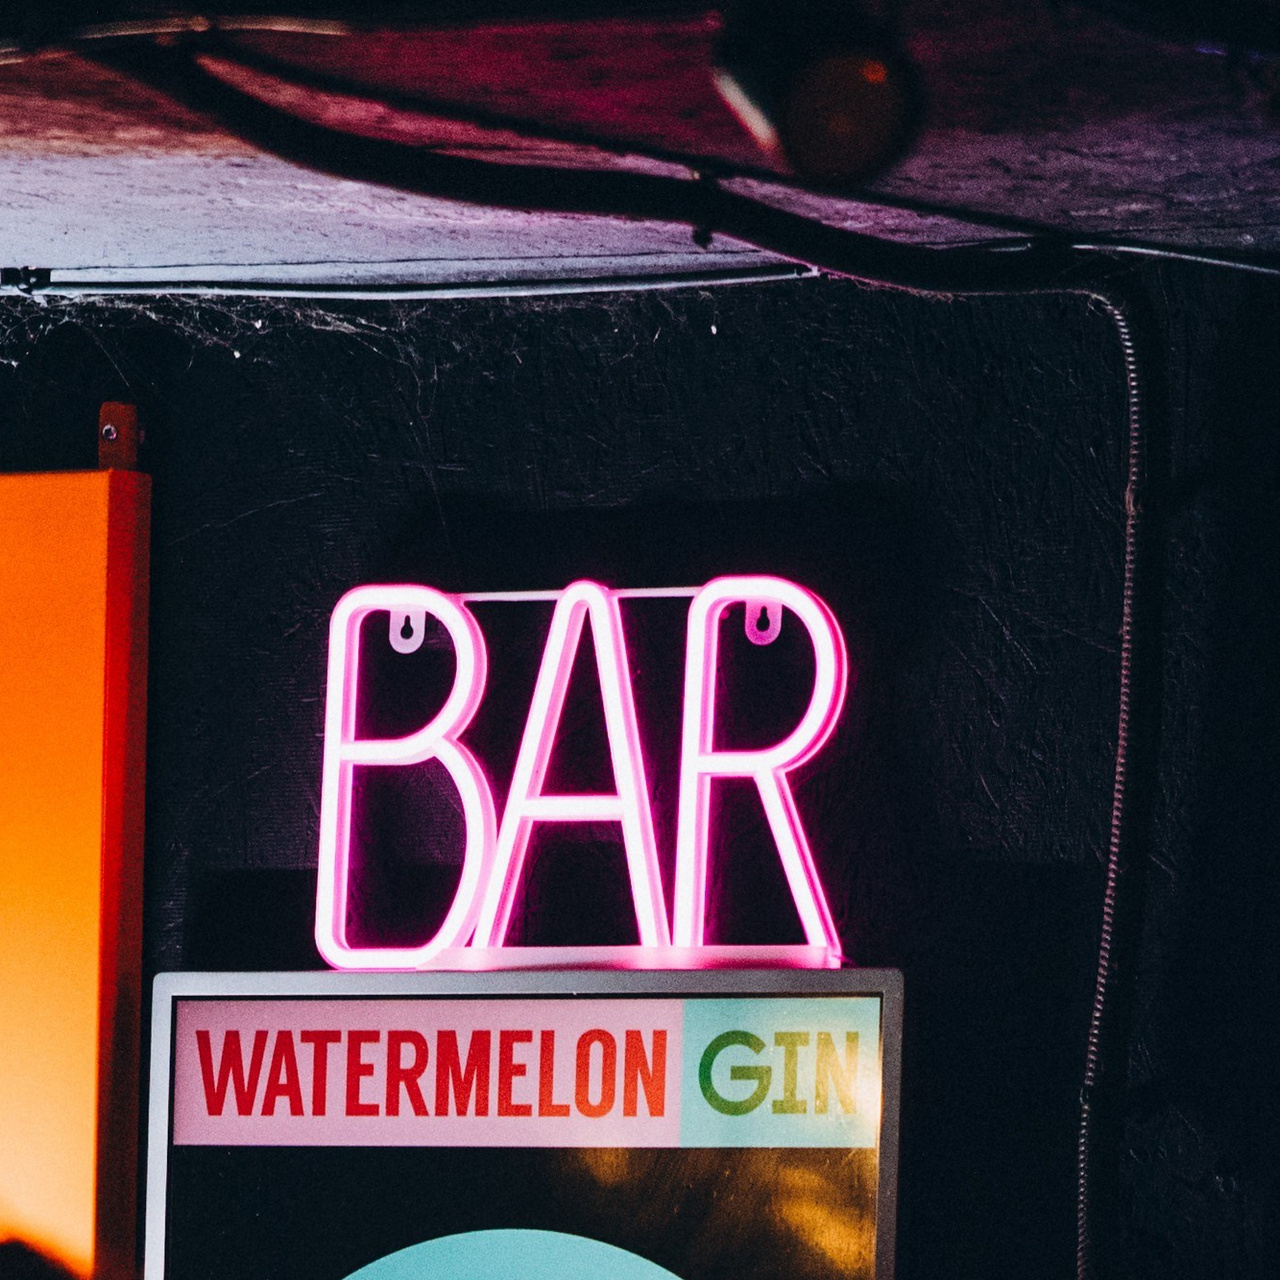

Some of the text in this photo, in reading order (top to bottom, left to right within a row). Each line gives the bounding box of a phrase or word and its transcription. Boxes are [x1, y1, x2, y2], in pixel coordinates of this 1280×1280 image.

[315, 575, 847, 969] BAR
[195, 1029, 859, 1120] WATERMELON GIN
